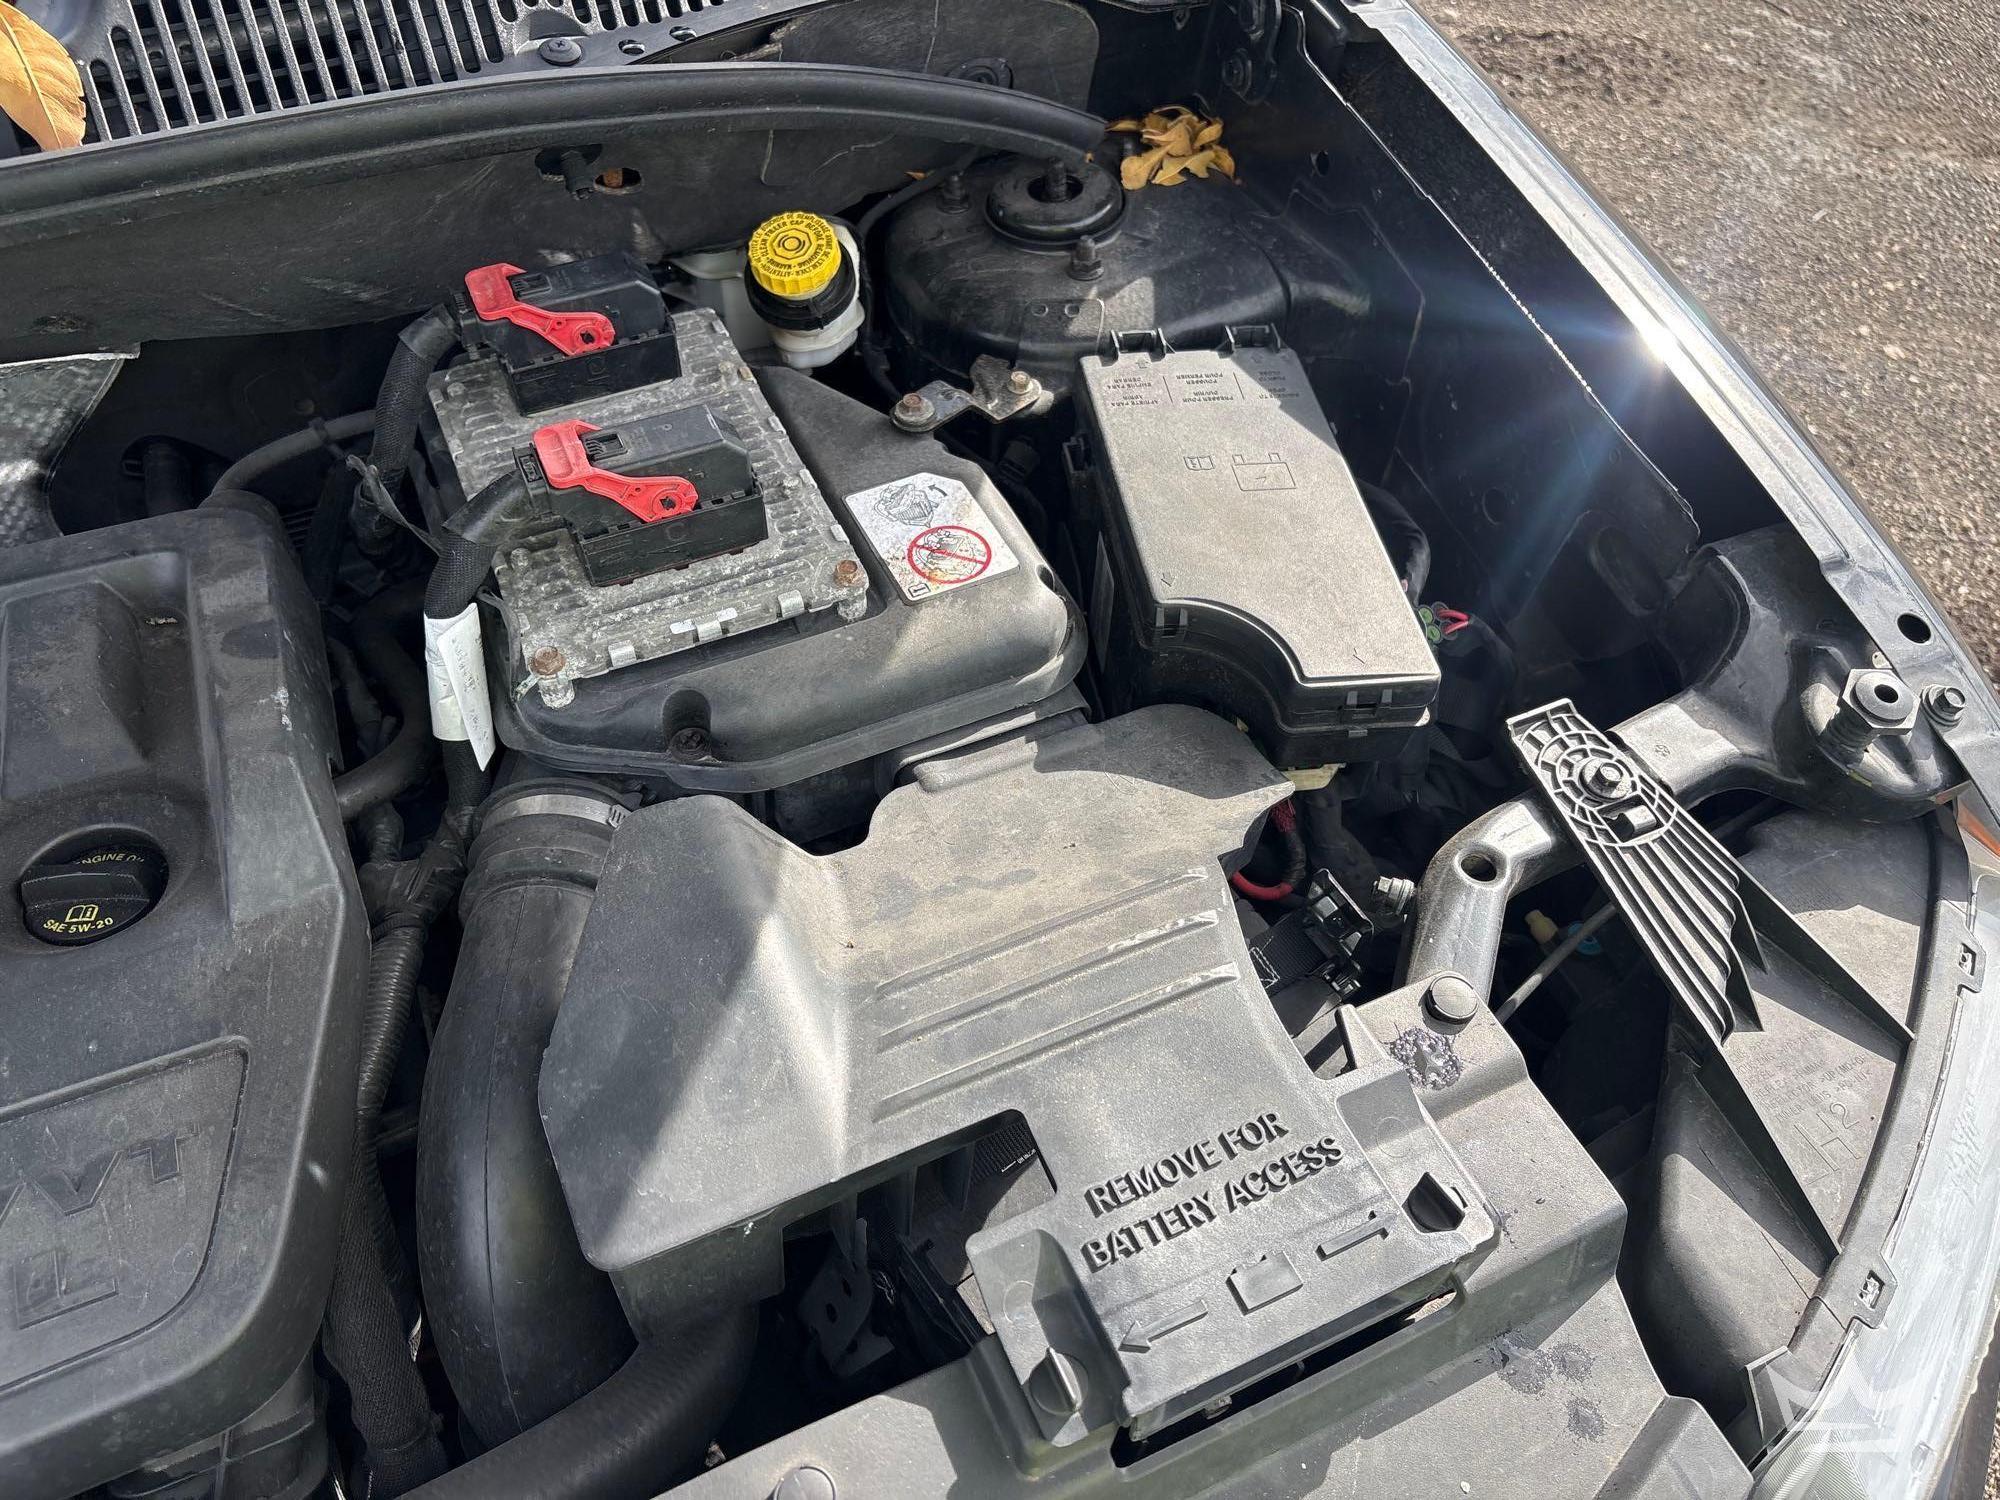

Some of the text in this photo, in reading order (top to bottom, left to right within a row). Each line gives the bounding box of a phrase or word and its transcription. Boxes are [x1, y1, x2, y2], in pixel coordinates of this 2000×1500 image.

[43, 917, 114, 934] SAE 5W-20
[1080, 1135, 1344, 1273] BATTERY ACCESS
[1084, 1111, 1289, 1218] REMOVE FOR
